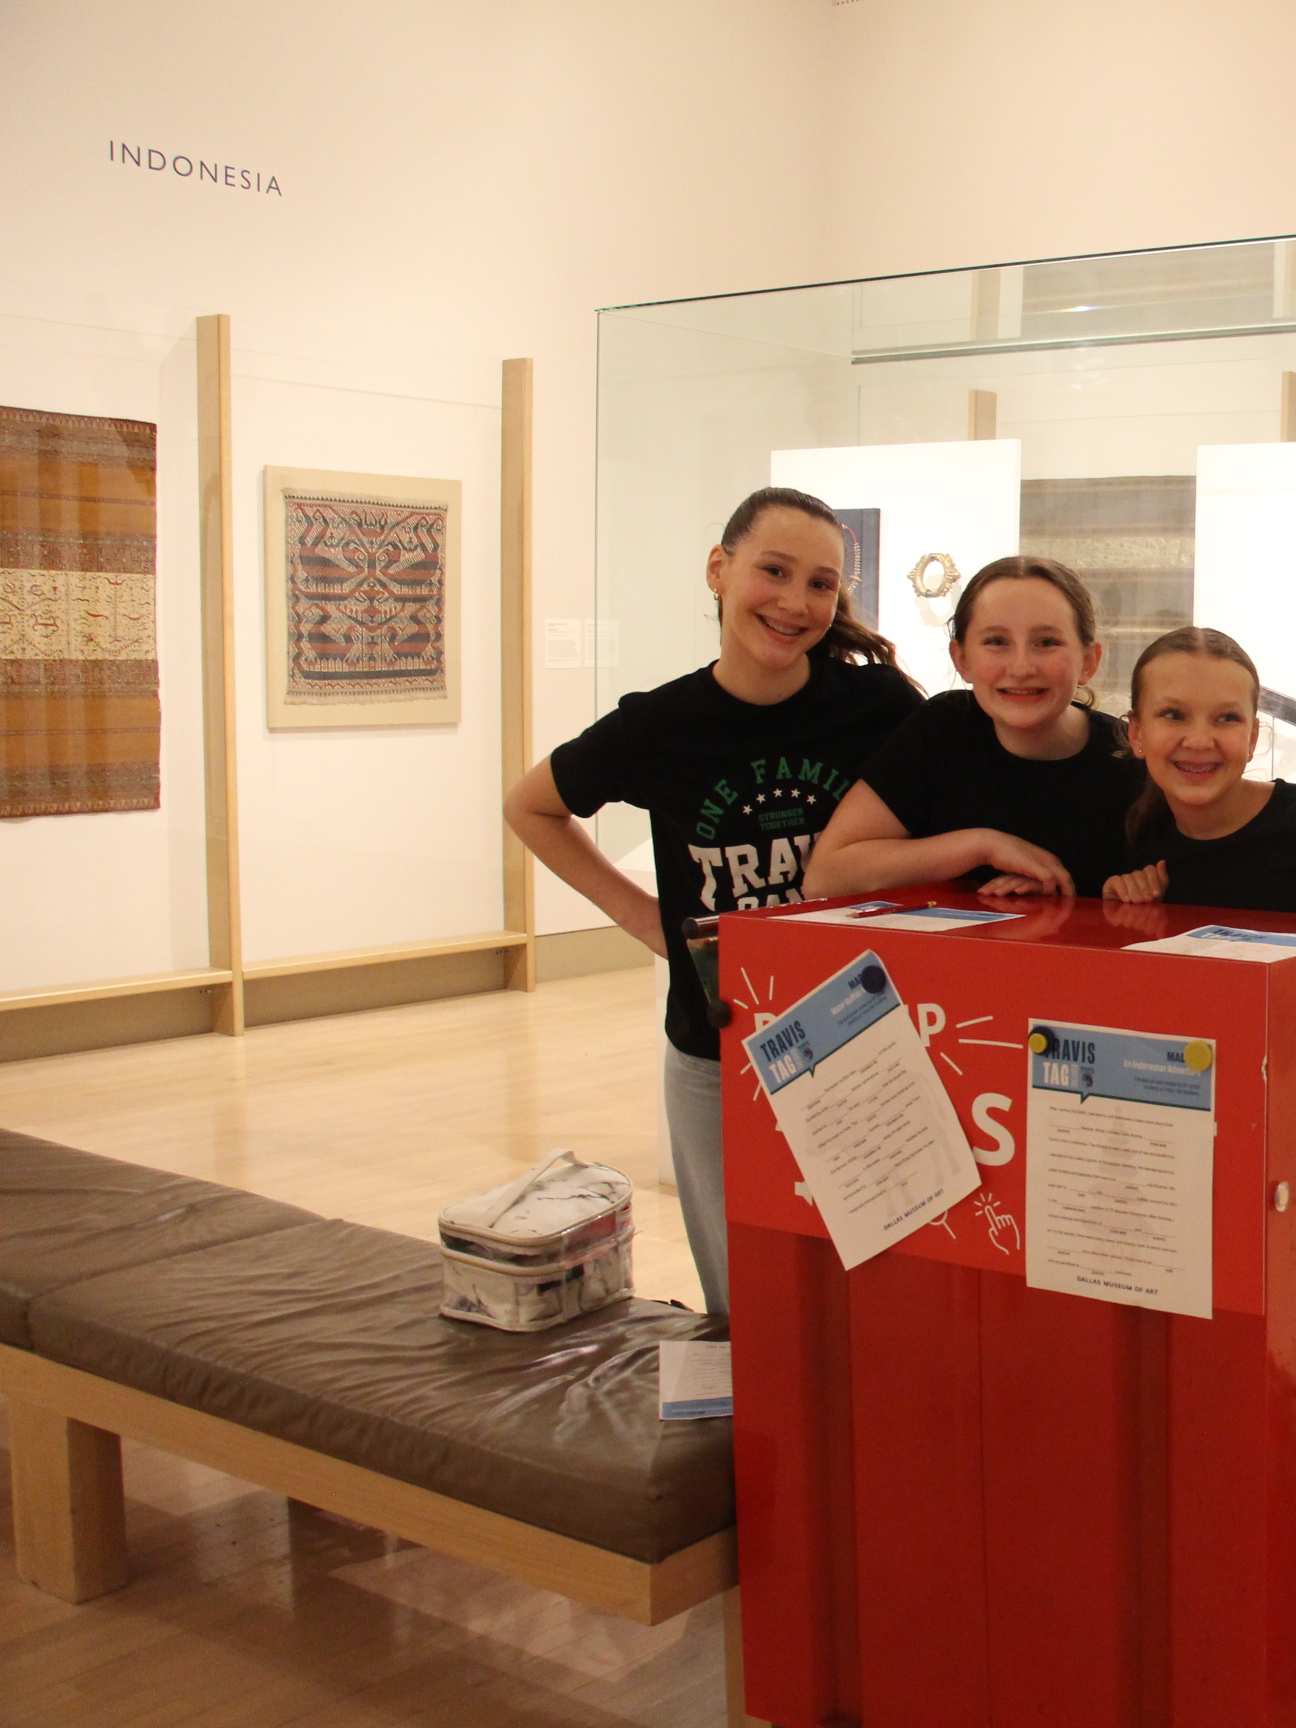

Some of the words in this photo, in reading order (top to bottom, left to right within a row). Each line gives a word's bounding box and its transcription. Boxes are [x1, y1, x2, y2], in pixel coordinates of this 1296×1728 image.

[109, 139, 282, 197] INDONESIA
[696, 779, 739, 840] ONE
[750, 756, 850, 801] FAMIL
[758, 807, 804, 823] STRONGER
[759, 817, 806, 832] TOGETHER
[688, 831, 823, 912] TRAV
[760, 1020, 806, 1062] TRAVIS
[768, 1054, 798, 1084] TAG
[1042, 1061, 1070, 1087] TAG
[883, 1214, 904, 1231] DALLAS
[904, 1199, 926, 1219] MUSEUM
[925, 1195, 935, 1204] OF
[933, 1188, 944, 1199] ART
[1076, 1275, 1101, 1286] DALLAS
[1103, 1280, 1133, 1291] MUSEUM
[1133, 1285, 1144, 1293] OF
[1145, 1287, 1159, 1295] ART
